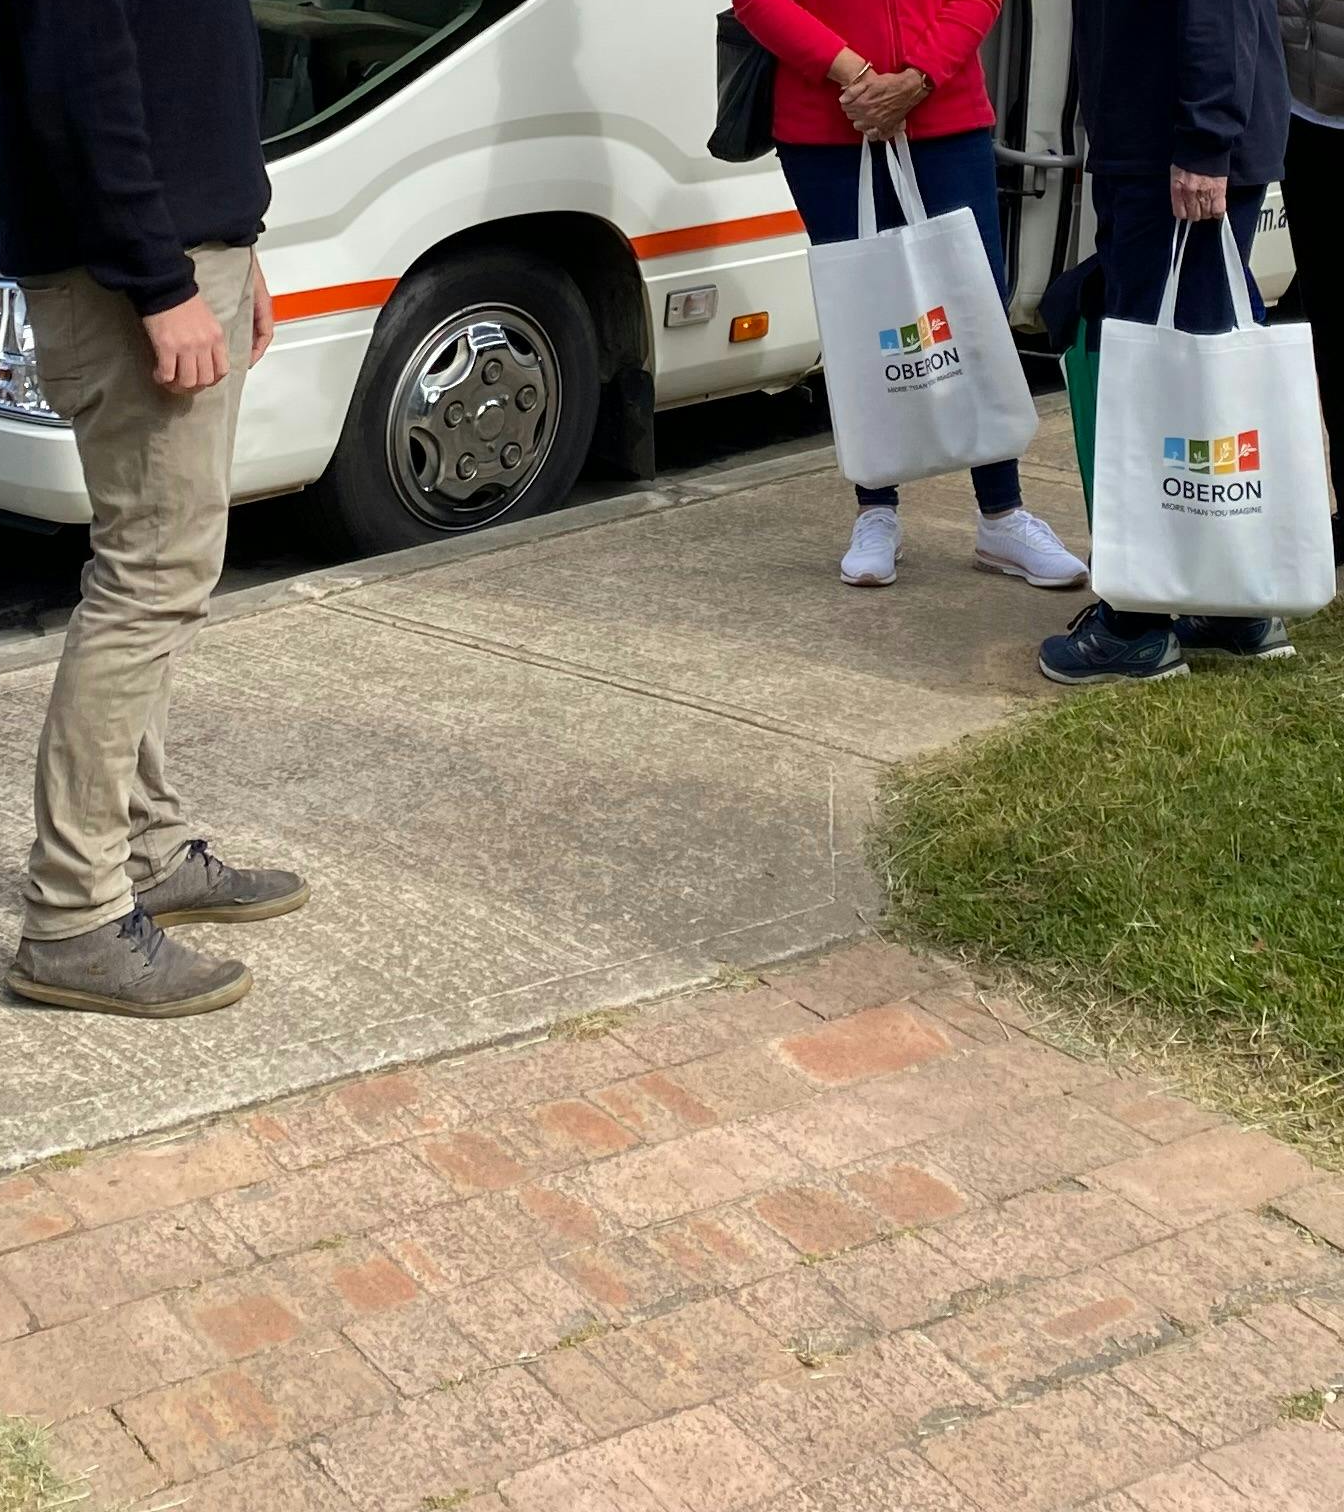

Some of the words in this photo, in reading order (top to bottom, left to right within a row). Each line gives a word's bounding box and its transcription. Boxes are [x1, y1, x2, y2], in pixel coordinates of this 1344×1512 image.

[885, 346, 960, 382] OBERON
[1162, 476, 1262, 503] OBERON
[1161, 501, 1185, 513] MORE
[1186, 505, 1209, 517] THAN
[1210, 508, 1229, 517] YOU
[1229, 505, 1263, 517] IMAGINE
